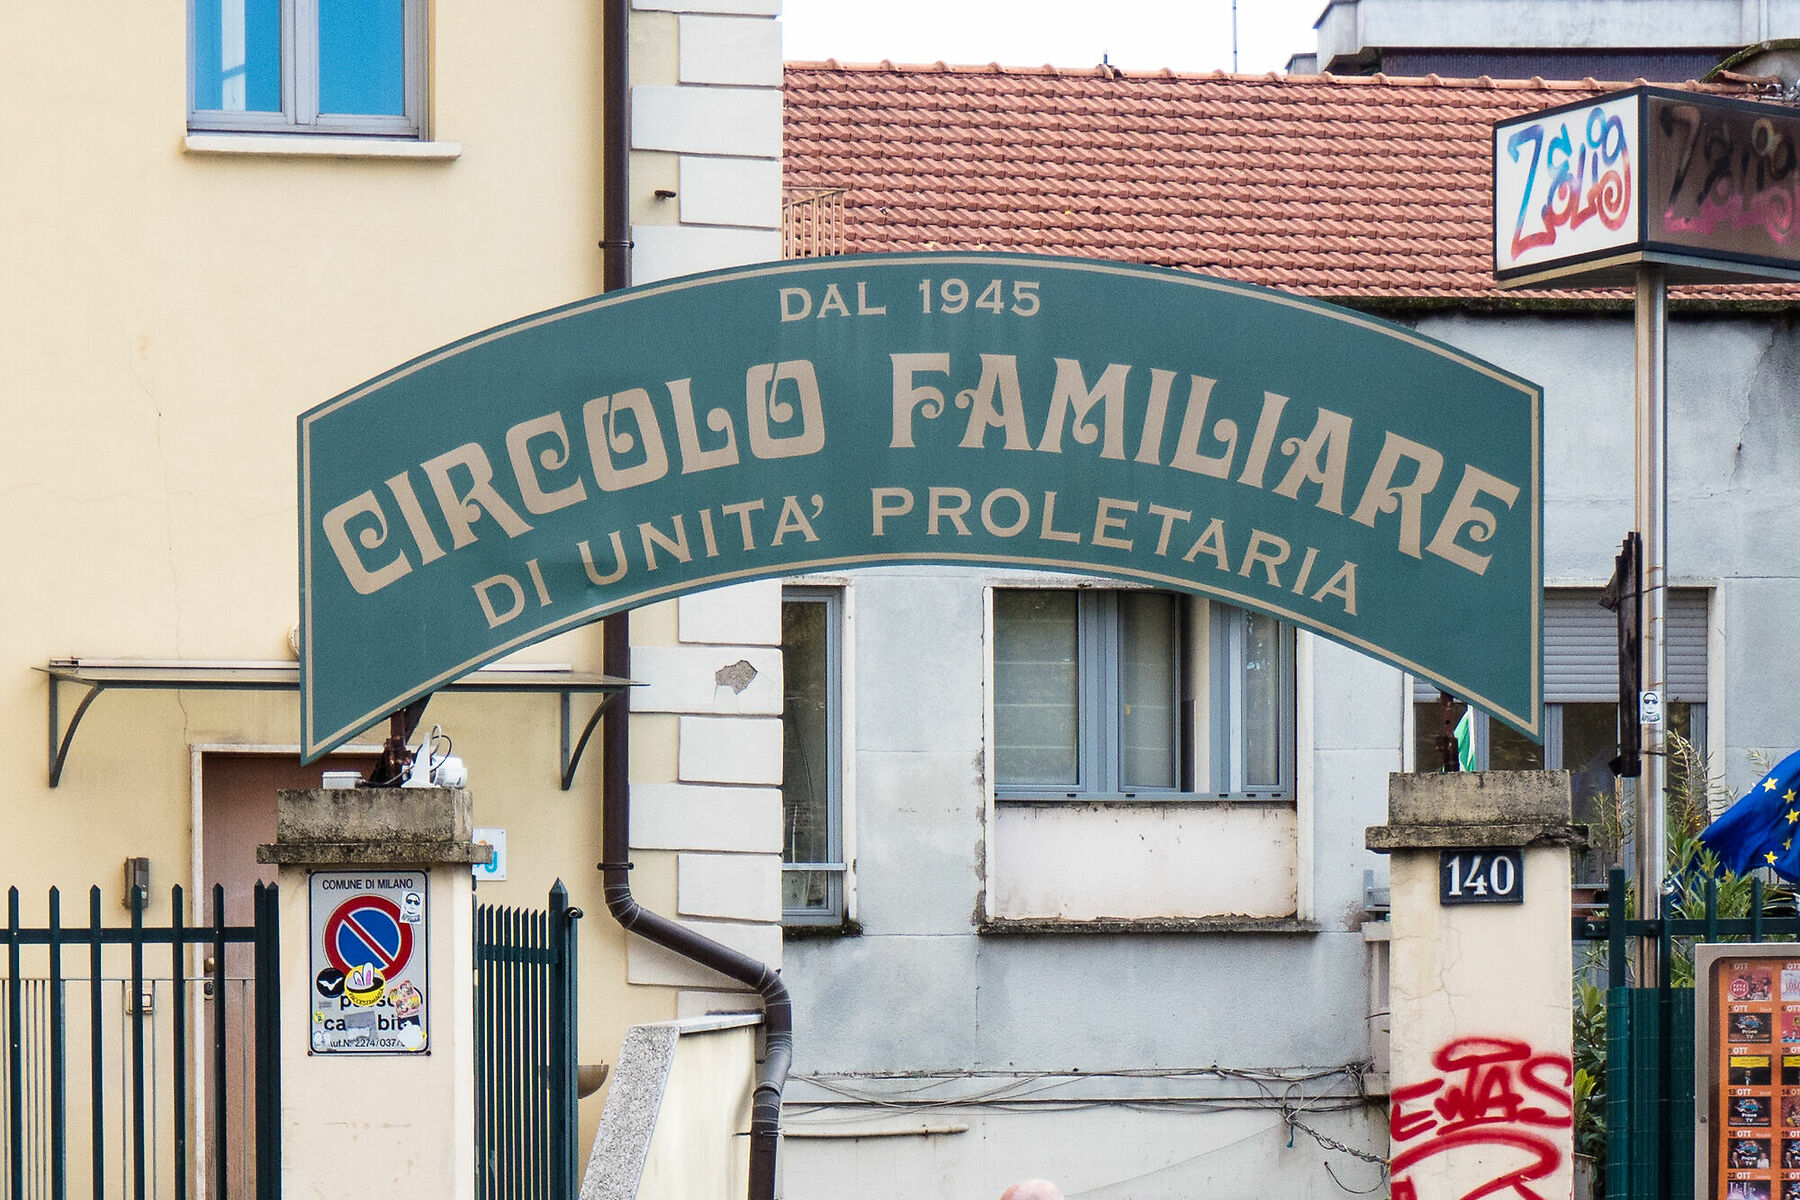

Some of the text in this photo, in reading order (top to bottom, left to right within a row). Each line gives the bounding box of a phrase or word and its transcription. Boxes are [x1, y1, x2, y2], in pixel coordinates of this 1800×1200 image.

[778, 277, 1041, 322] DAL 1945
[322, 352, 1521, 595] CIRCOLO FAMILIARE
[472, 558, 553, 629] DI
[871, 486, 1358, 616] PROLETARIA
[322, 878, 414, 890] COMUNE DI MILANO
[1446, 855, 1515, 896] 140
